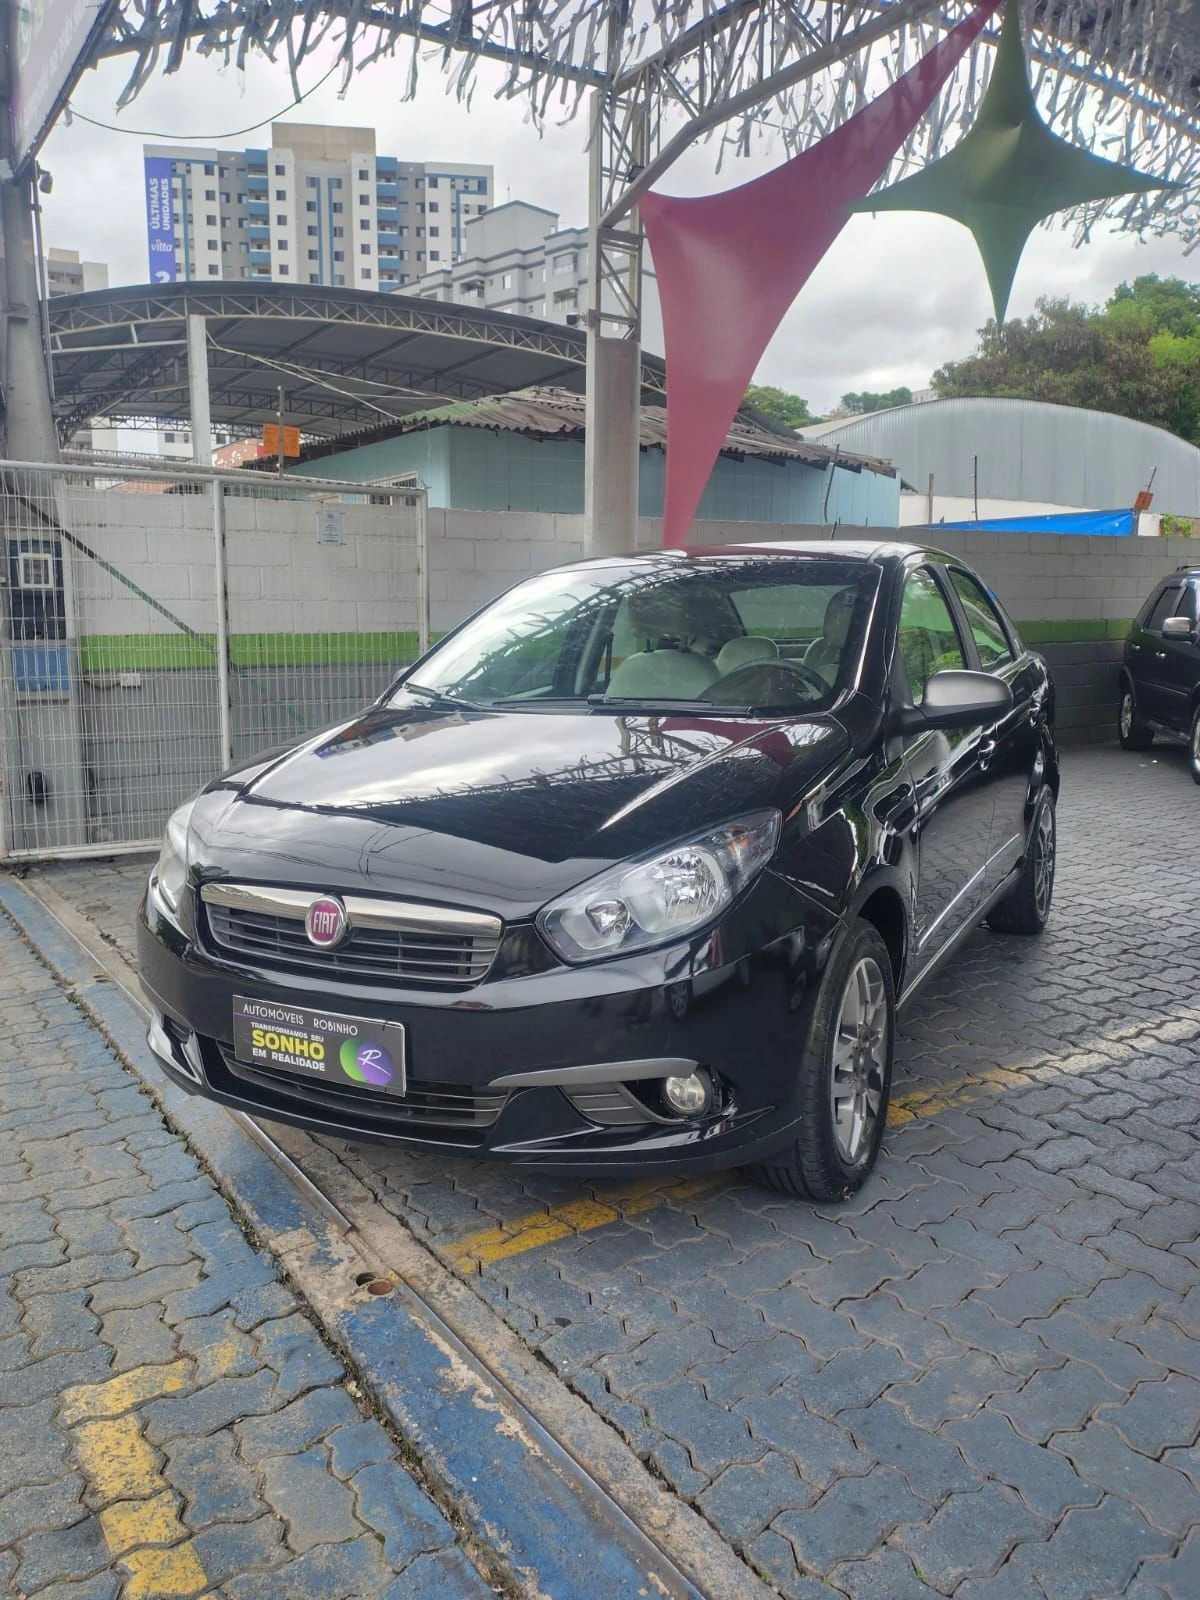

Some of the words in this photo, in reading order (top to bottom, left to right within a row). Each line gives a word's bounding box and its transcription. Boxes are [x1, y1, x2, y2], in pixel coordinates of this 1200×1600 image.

[149, 178, 160, 230] ÚLTIMAS
[160, 178, 170, 230] UNIDADES
[151, 239, 172, 252] vitta
[313, 911, 337, 934] FIAT
[243, 1004, 304, 1025] AUTOMÓVEIS
[313, 1017, 358, 1036] ROBINHO
[250, 1021, 308, 1040] TRANSFORMAMOS
[311, 1034, 324, 1043] SEU
[252, 1029, 325, 1060] SONHO
[252, 1048, 267, 1059] EM
[271, 1051, 326, 1072] REALIDADE
